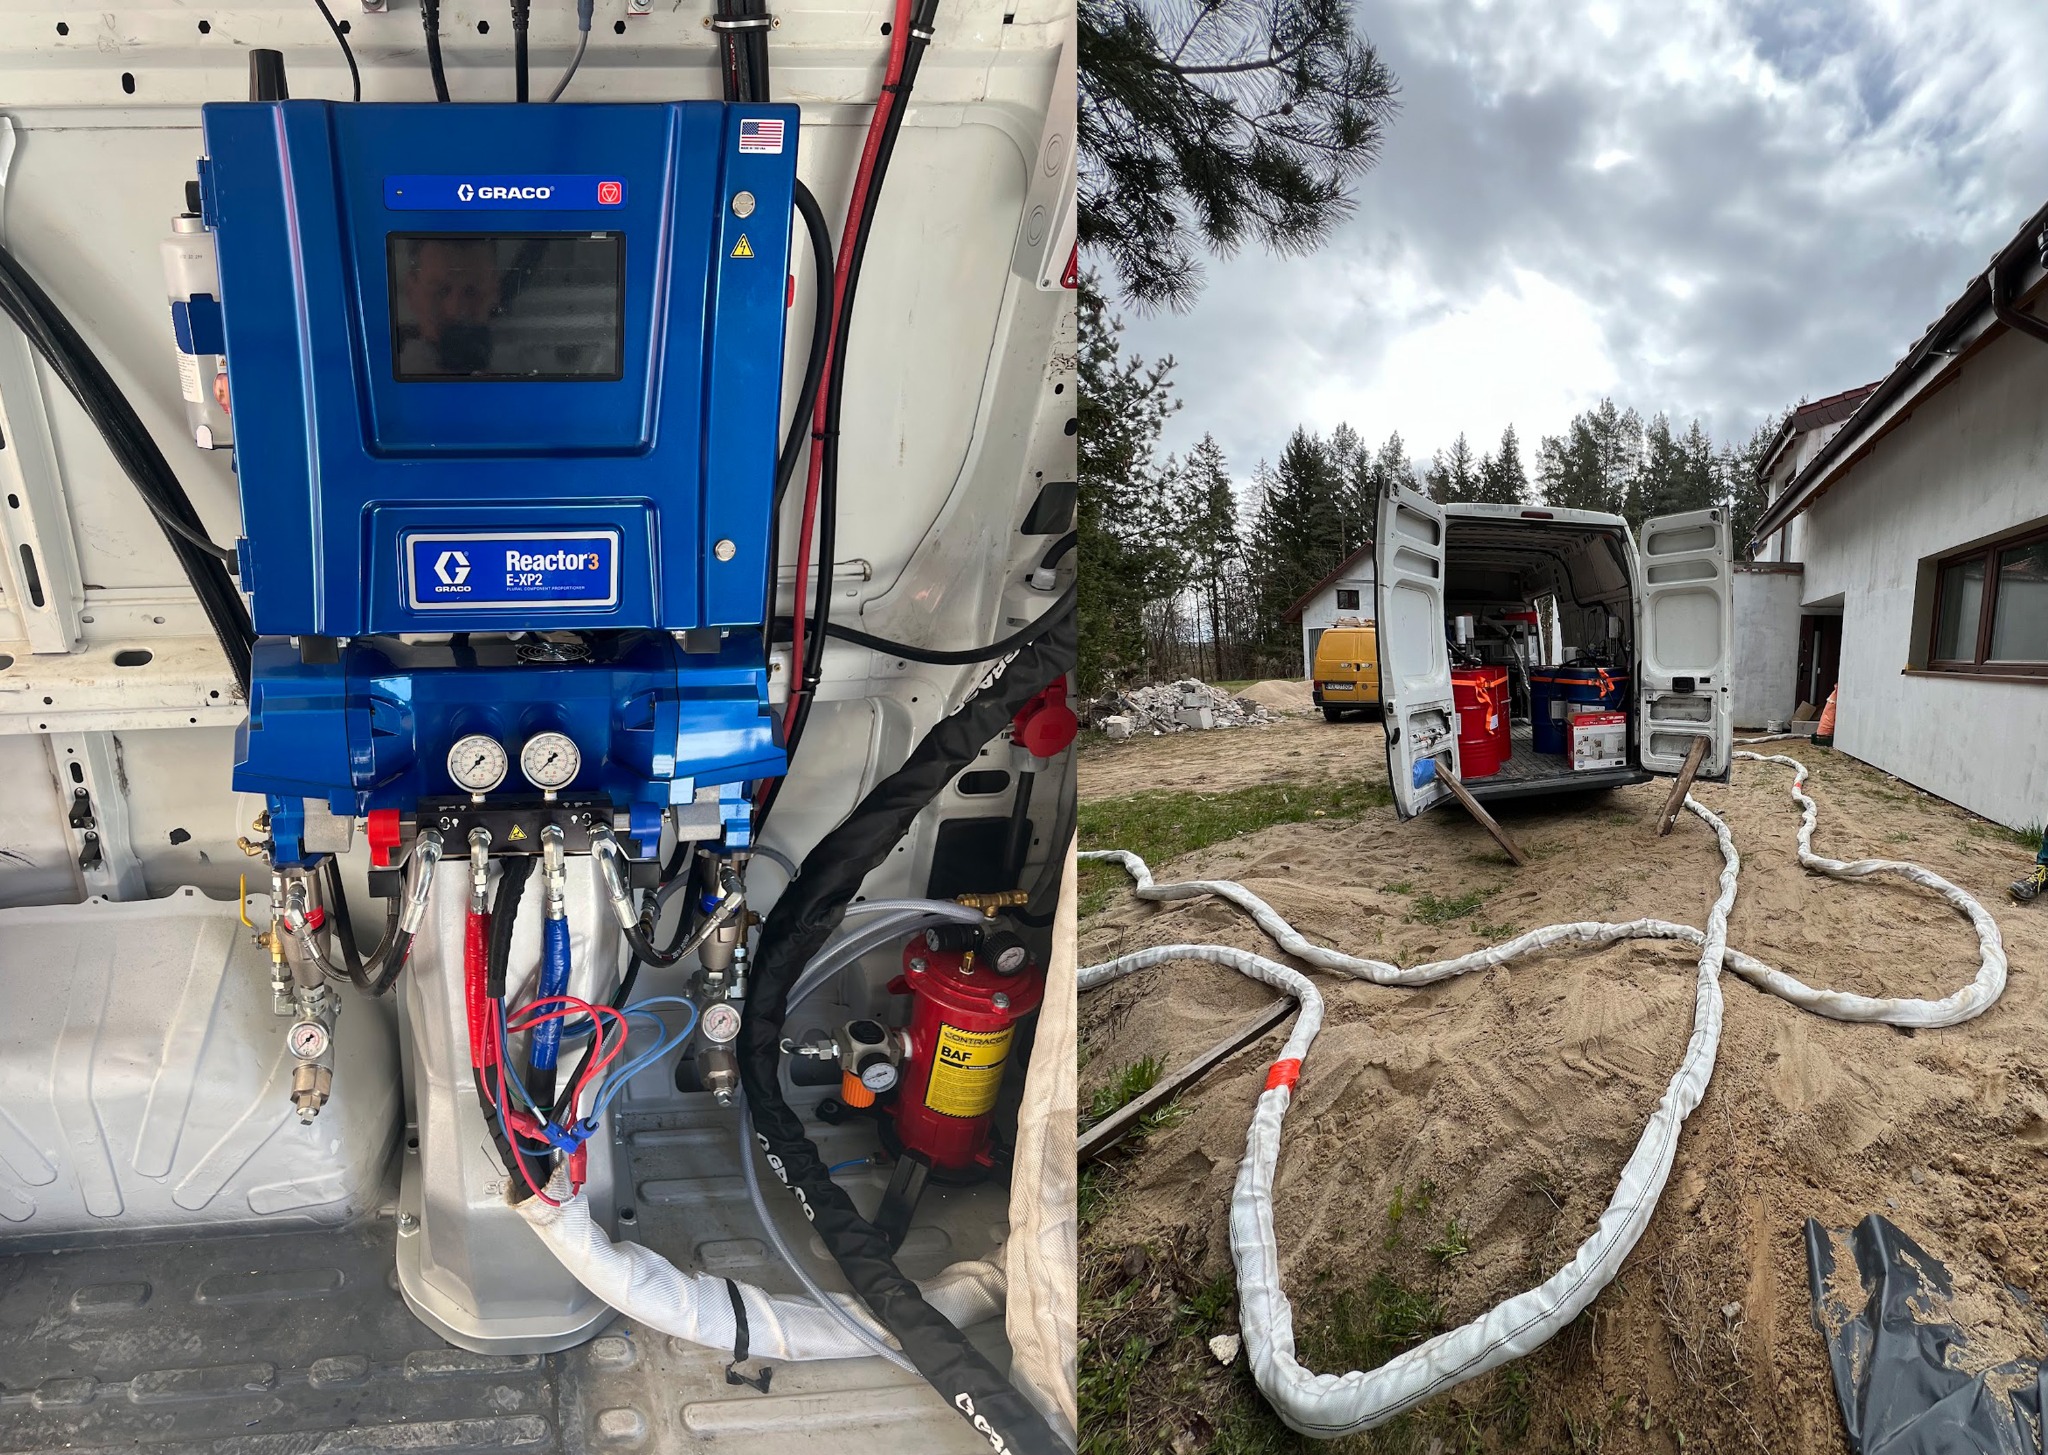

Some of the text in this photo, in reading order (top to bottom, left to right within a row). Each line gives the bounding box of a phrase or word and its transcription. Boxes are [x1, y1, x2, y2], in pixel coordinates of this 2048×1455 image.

[506, 573, 543, 586] E-XP2
[435, 585, 472, 593] GRACO
[941, 1045, 973, 1062] BAF
